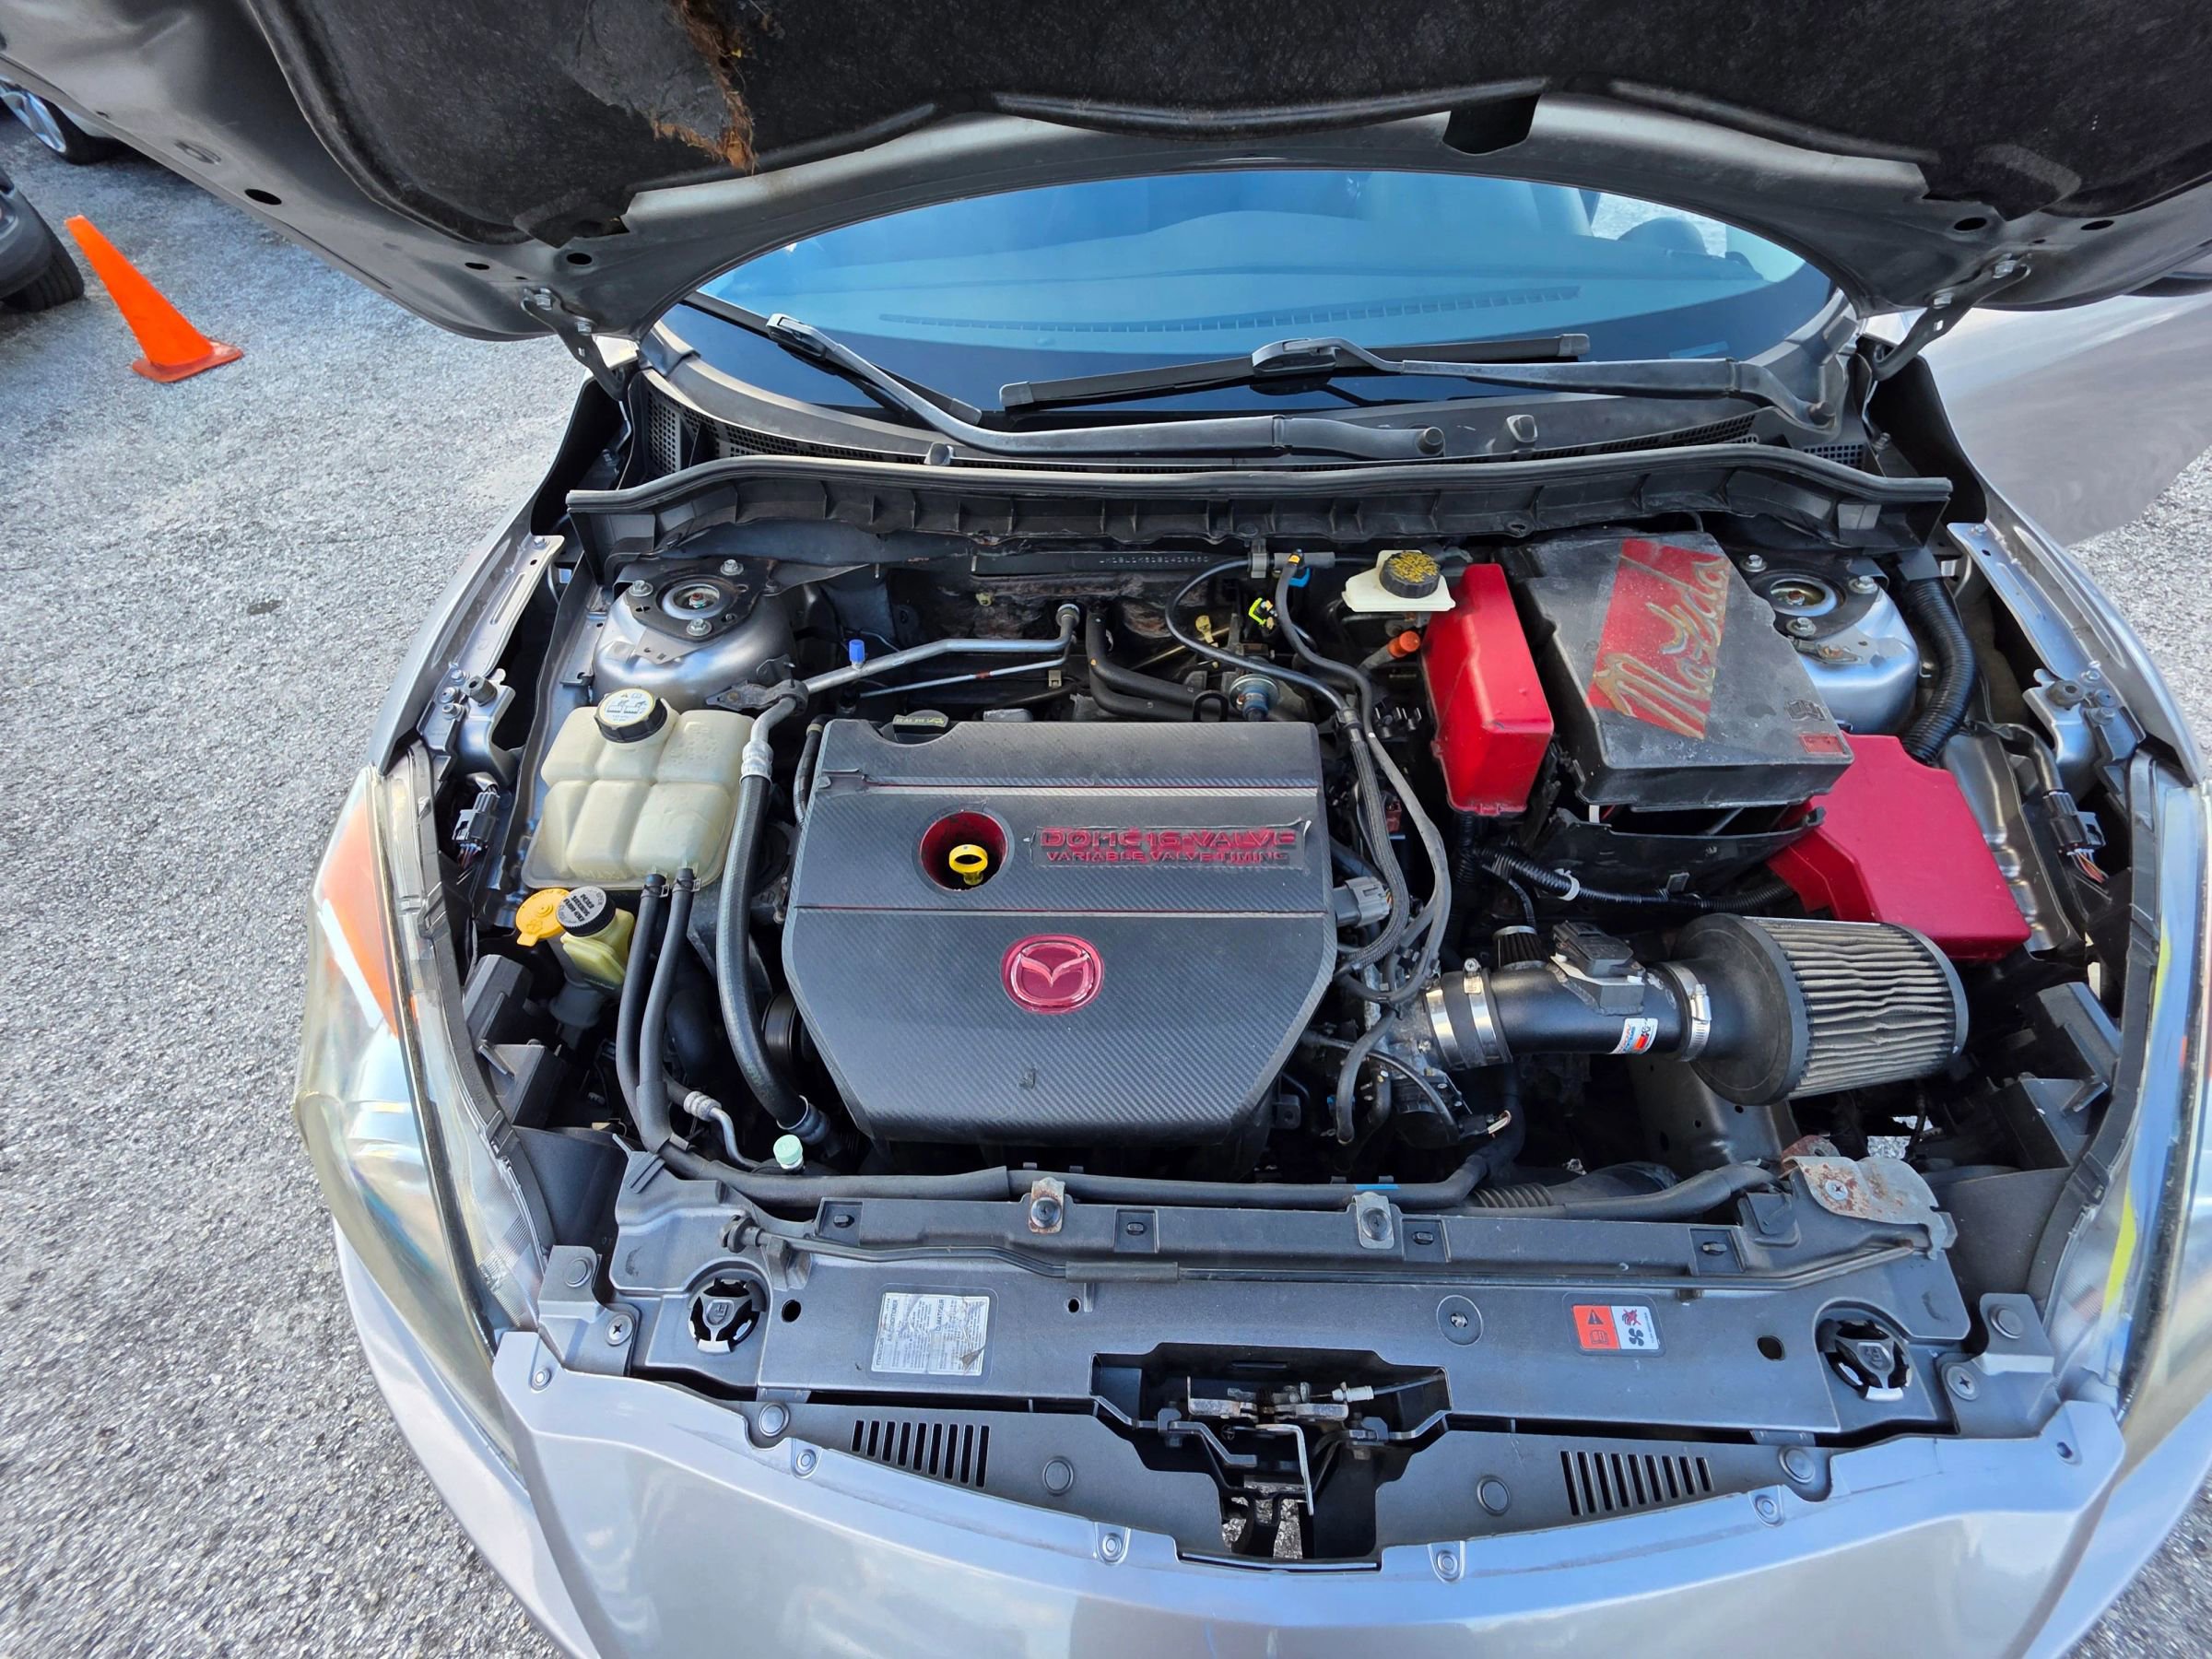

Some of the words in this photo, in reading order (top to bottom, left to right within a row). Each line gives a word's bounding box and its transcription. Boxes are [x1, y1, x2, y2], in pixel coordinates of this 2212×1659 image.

[1041, 828, 1142, 848] DOHC
[1145, 829, 1296, 848] 16-VALVE
[1047, 851, 1146, 863] VARIABLE
[1149, 851, 1212, 863] VALVE
[1214, 851, 1289, 864] TIMING
